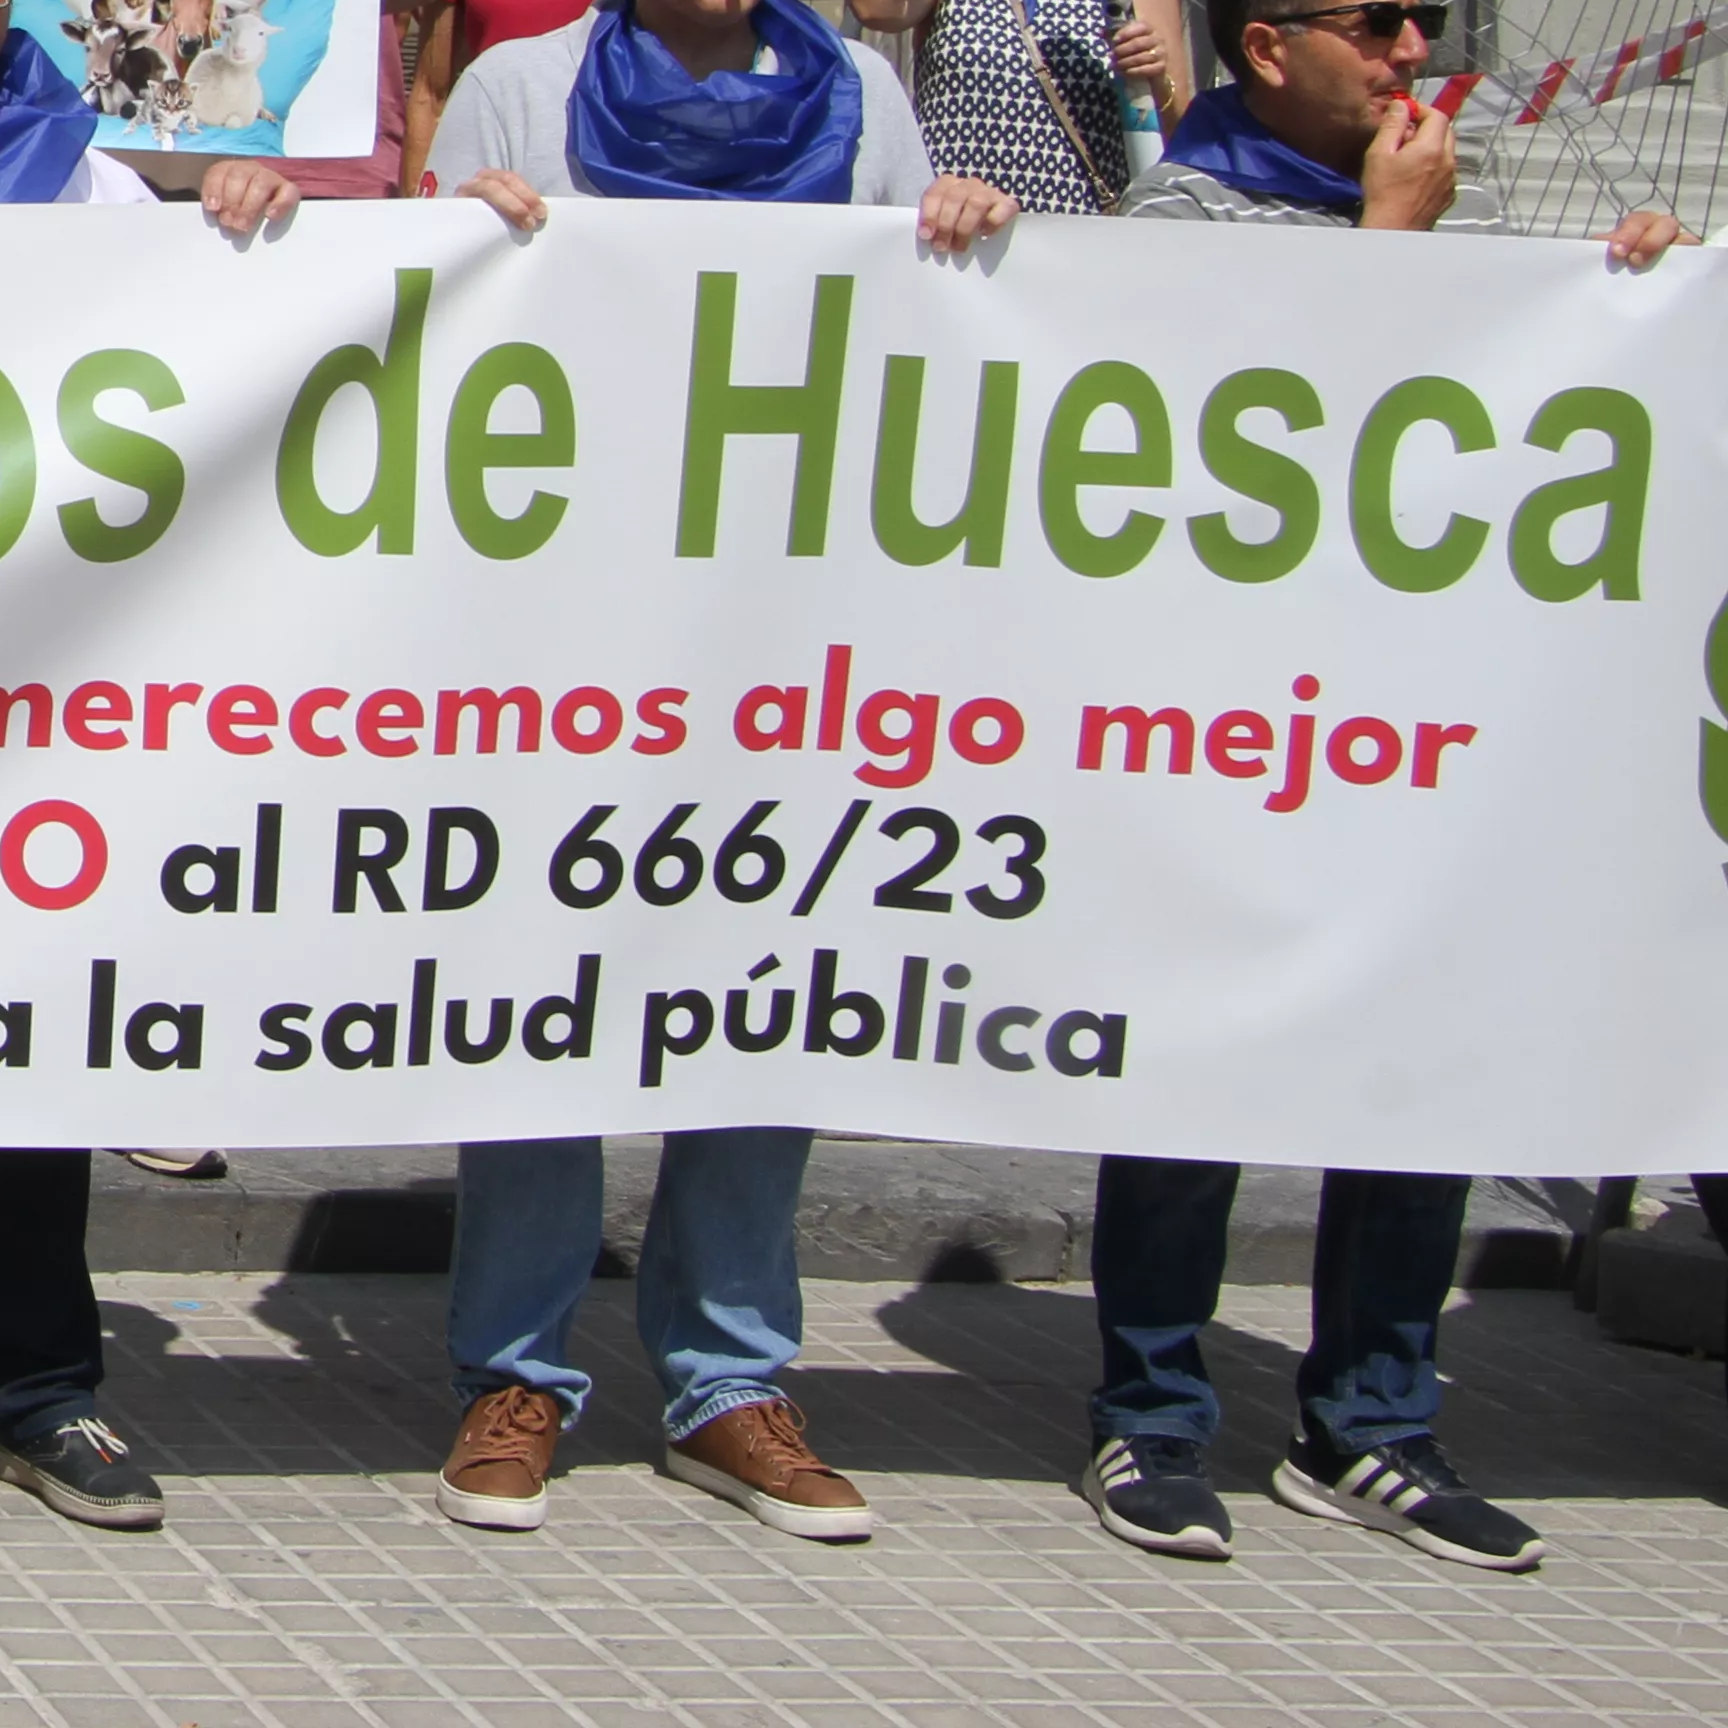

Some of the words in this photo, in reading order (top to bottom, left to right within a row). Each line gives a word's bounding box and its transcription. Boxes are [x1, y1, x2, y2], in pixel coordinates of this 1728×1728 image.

[275, 267, 576, 562] de
[673, 268, 1654, 605] Huesca
[731, 644, 1027, 790] algo
[1075, 673, 1478, 813] mejor
[159, 802, 283, 915] al
[331, 805, 500, 915] RD
[546, 797, 1049, 921] 666/23
[85, 959, 204, 1071] la
[253, 952, 603, 1071] salud
[636, 947, 1130, 1089] pública
